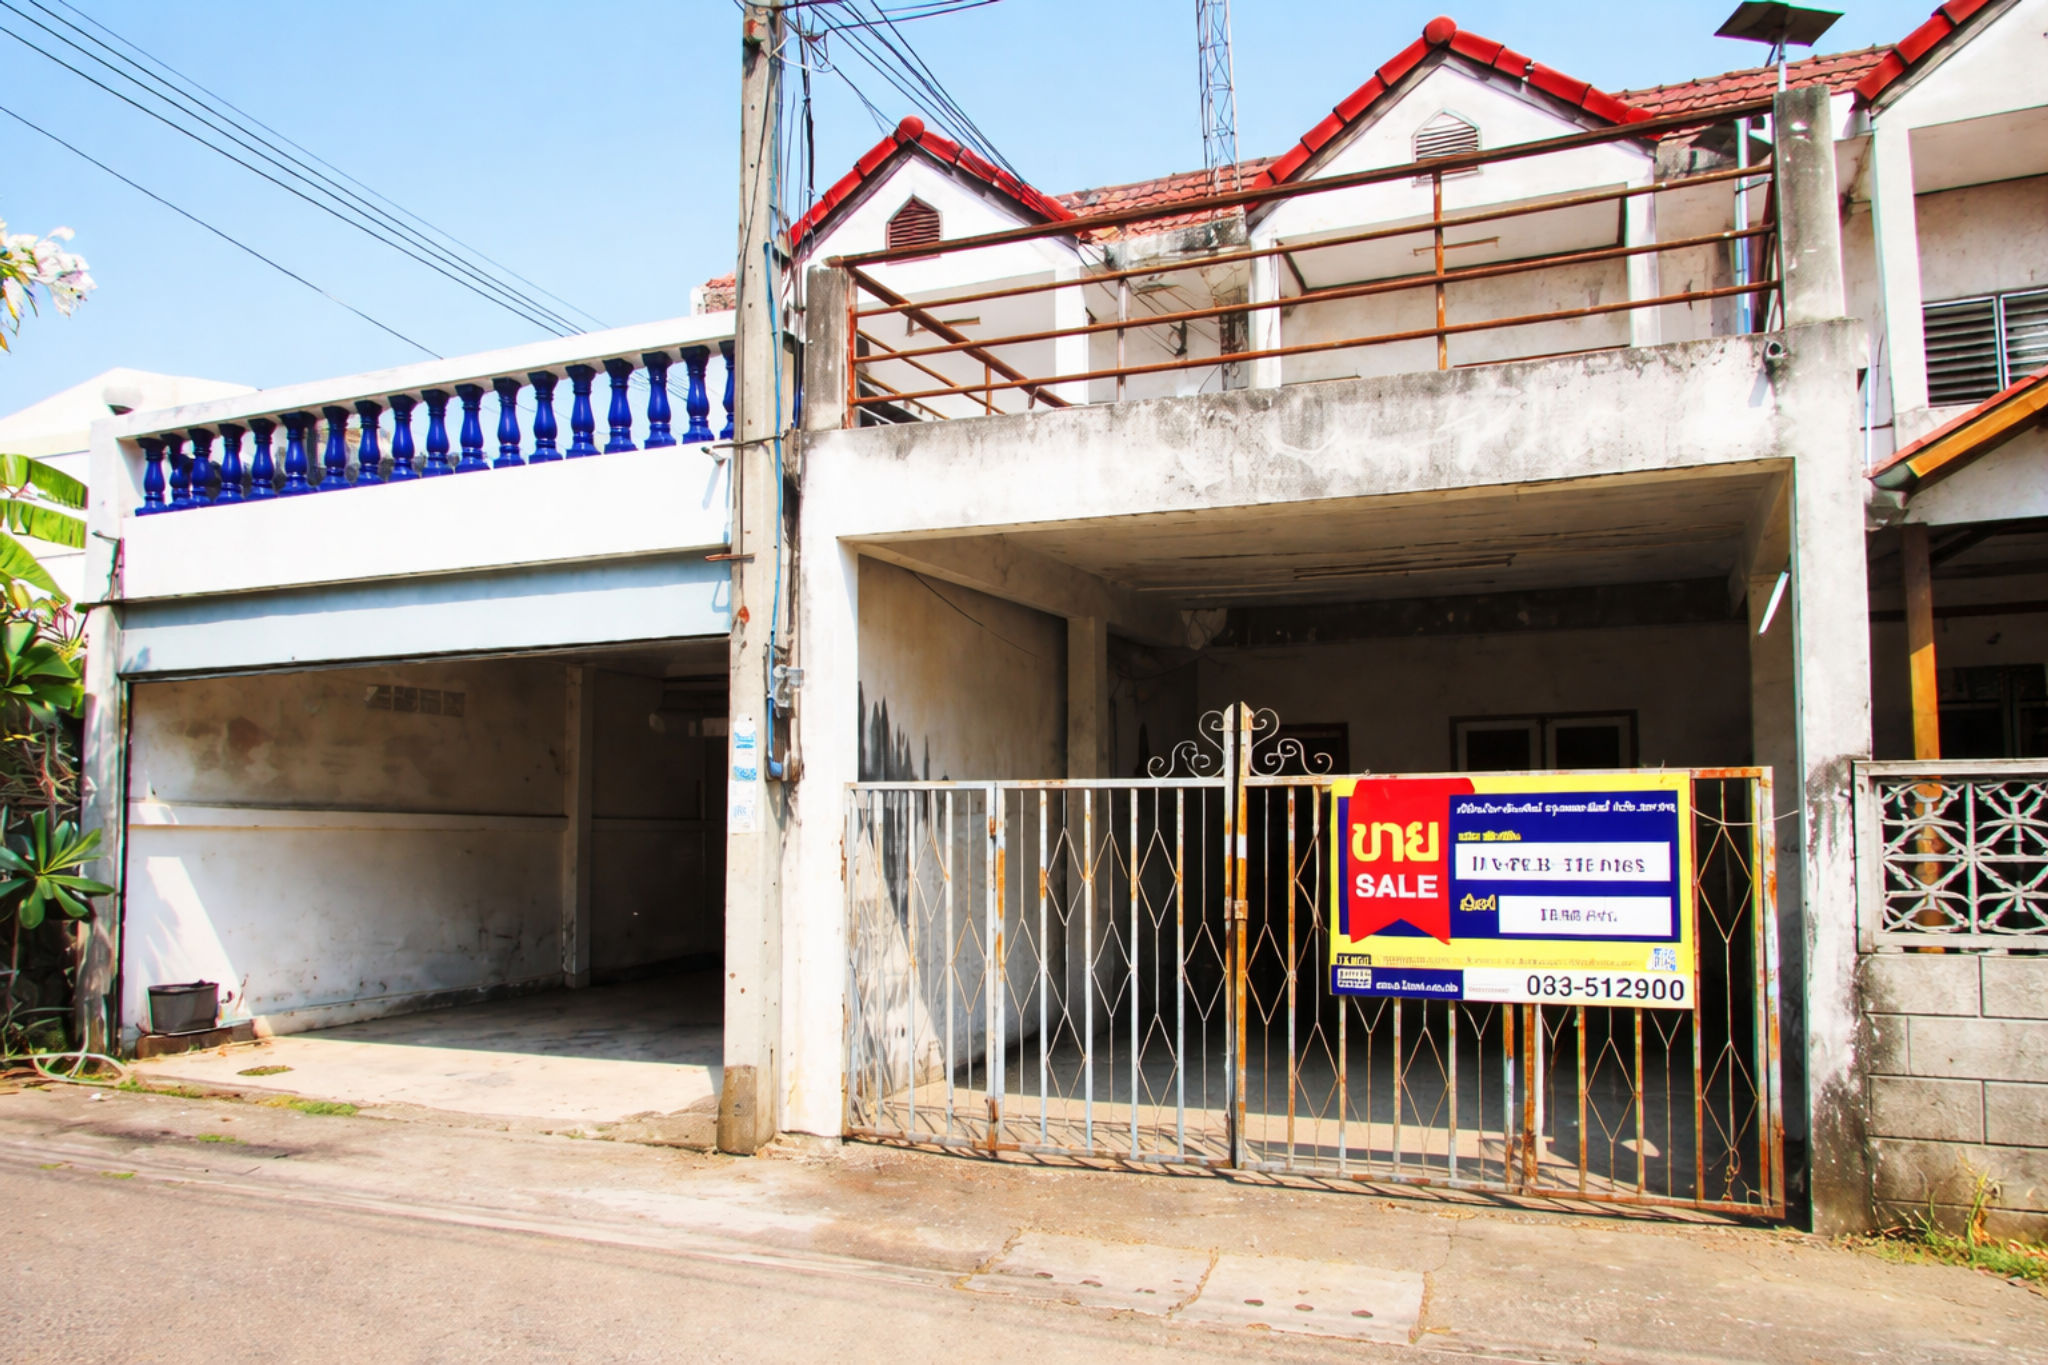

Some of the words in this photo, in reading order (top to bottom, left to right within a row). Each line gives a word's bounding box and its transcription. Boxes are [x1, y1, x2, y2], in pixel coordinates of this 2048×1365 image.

[1352, 821, 1439, 862] ขาย
[1355, 873, 1439, 898] SALE
[1527, 974, 1685, 1001] 033-512900
